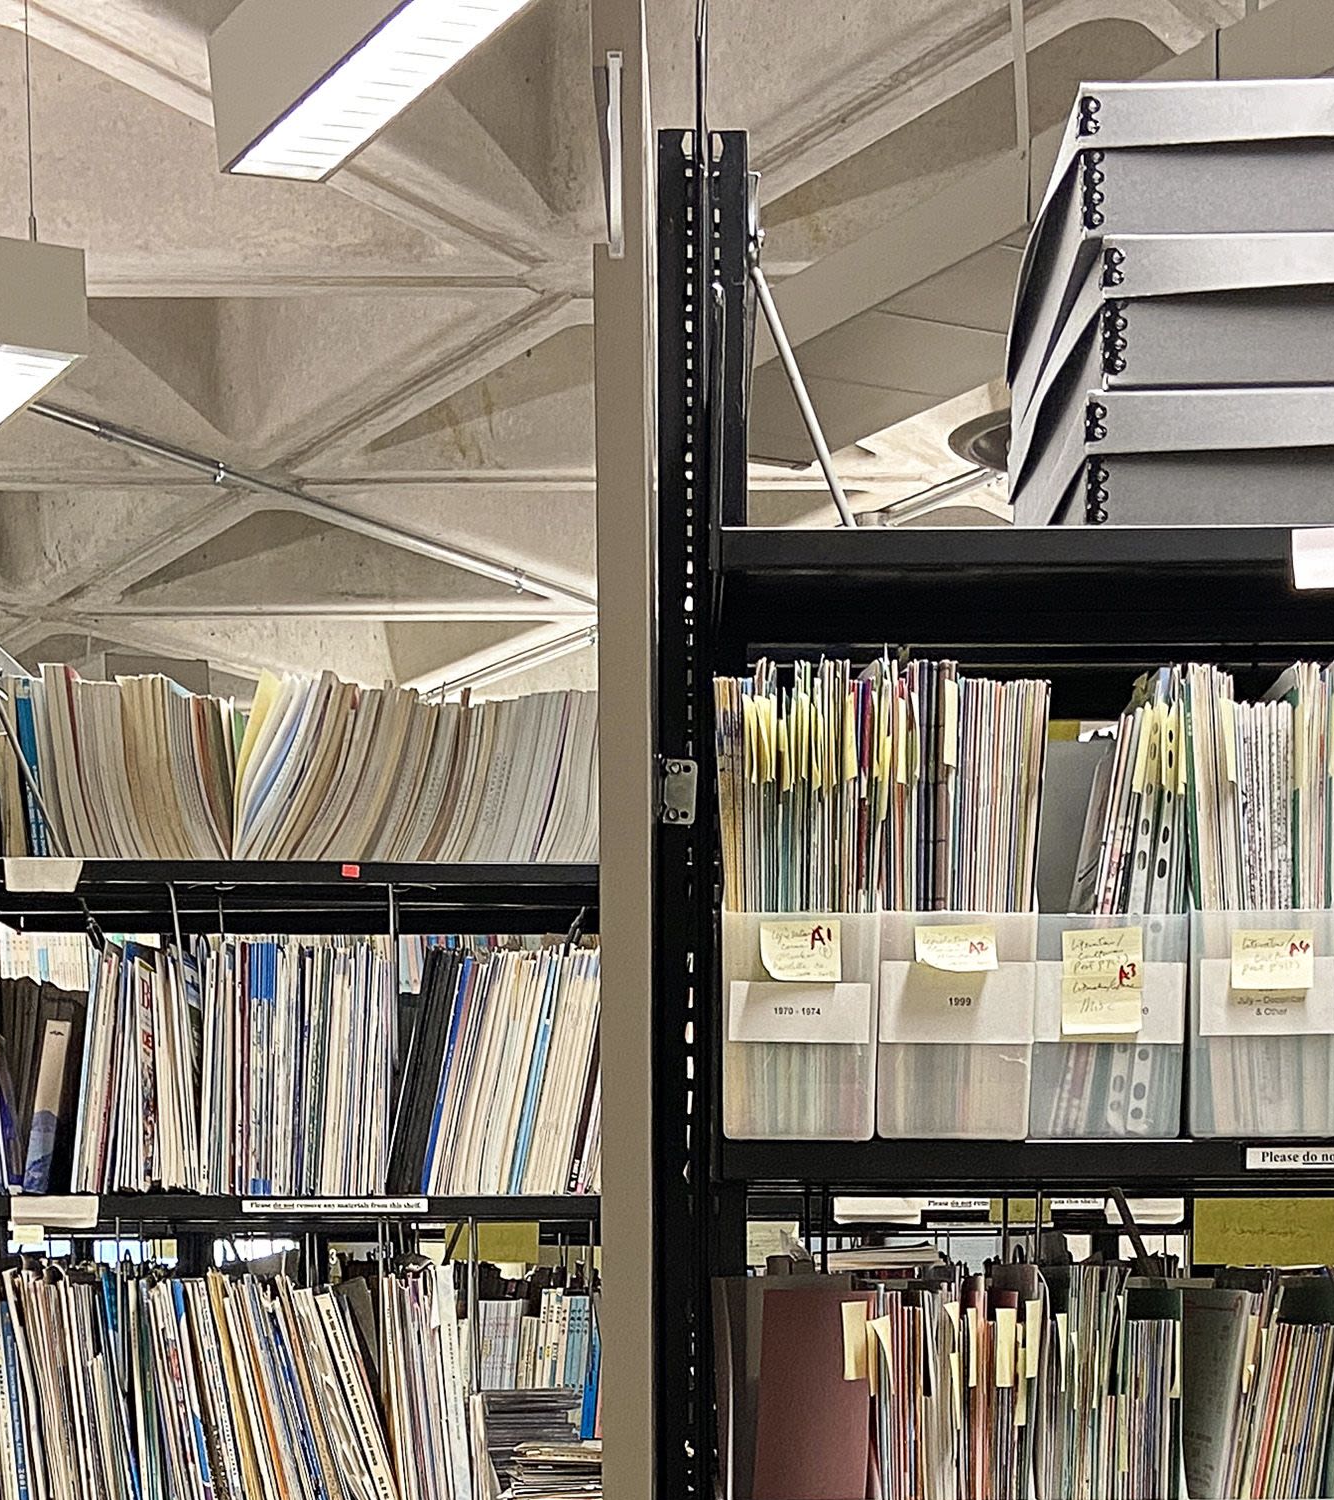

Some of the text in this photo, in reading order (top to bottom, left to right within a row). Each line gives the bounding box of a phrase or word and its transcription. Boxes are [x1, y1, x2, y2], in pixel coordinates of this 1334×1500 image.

[810, 925, 833, 950] A1
[968, 941, 989, 955] A2
[1118, 963, 1137, 986] A3
[948, 997, 972, 1006] 1999
[773, 1007, 794, 1016] 1970
[801, 1007, 821, 1016] 1974
[1263, 1007, 1288, 1016] Other
[1261, 1151, 1299, 1163] Please
[1302, 1150, 1318, 1164] do
